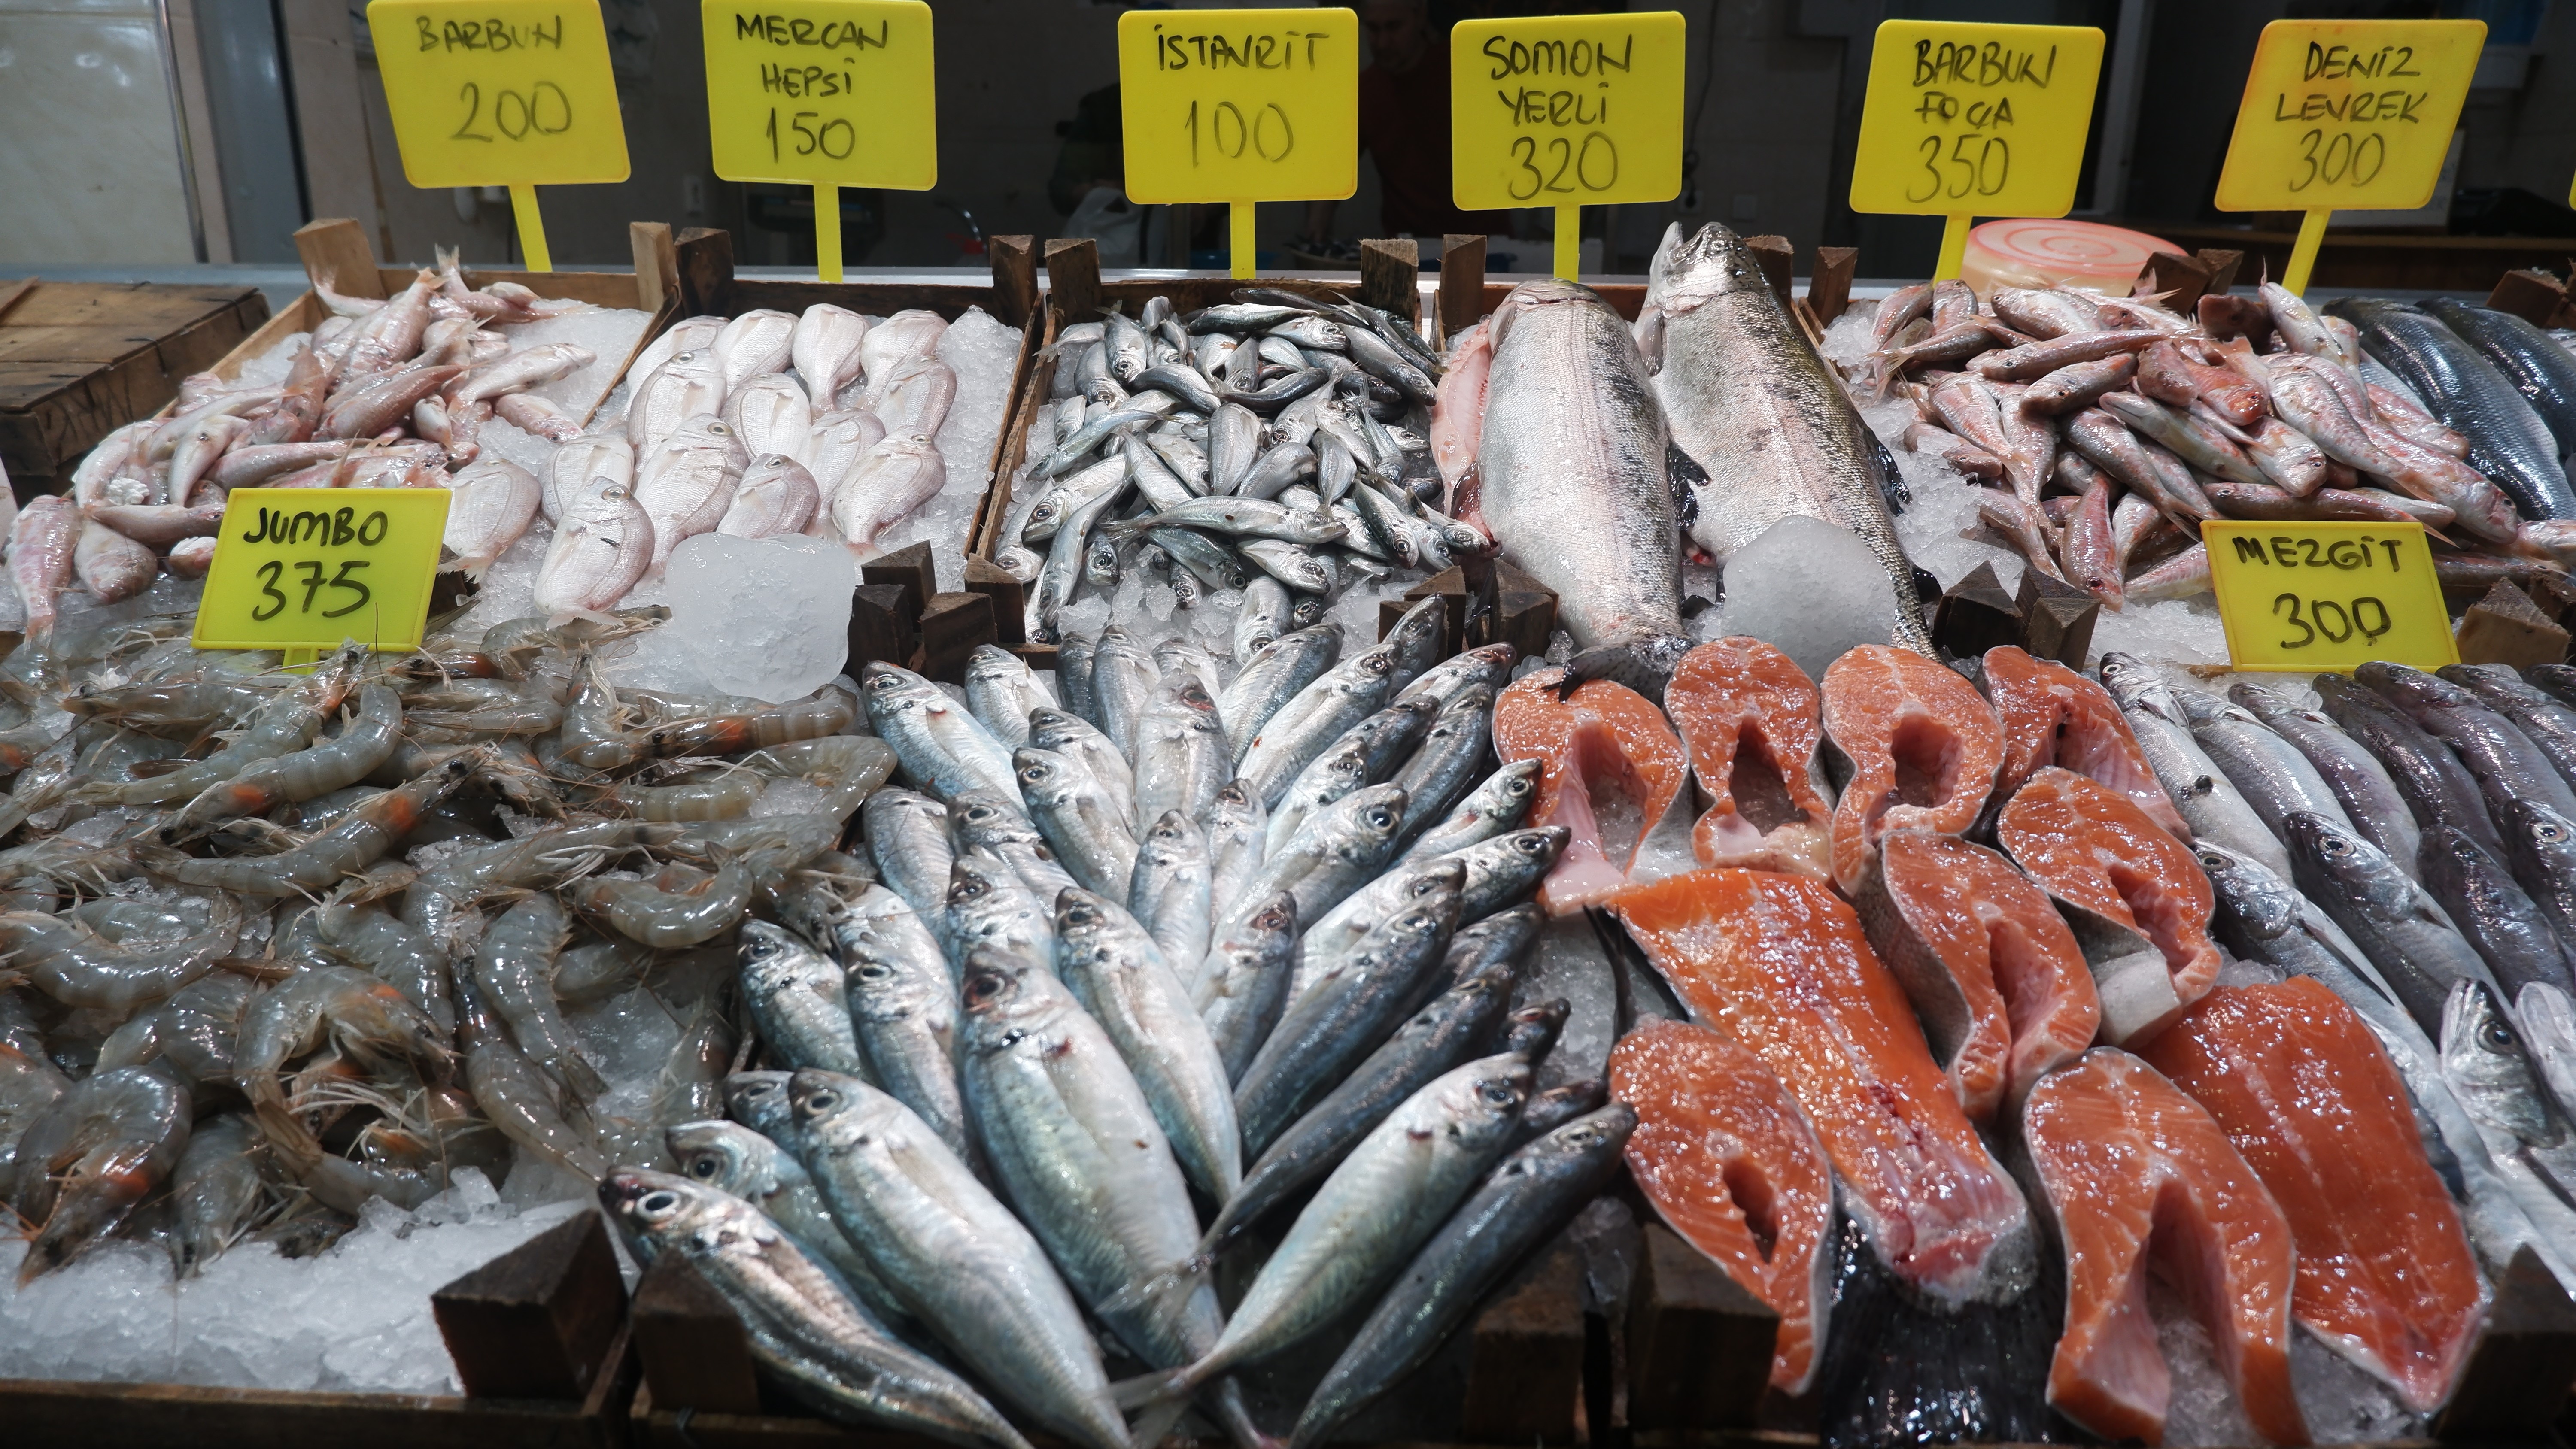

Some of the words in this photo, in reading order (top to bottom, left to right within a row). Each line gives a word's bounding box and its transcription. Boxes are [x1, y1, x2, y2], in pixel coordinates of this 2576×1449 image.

[416, 15, 562, 53] BARBUN
[736, 13, 888, 51] MERCAN
[1154, 24, 1330, 71] İSTAVRİT
[761, 57, 855, 99] HEPSİ
[1483, 34, 1633, 80] SOMON
[1913, 39, 2057, 89] BARBUN
[2304, 40, 2421, 82] DENİZ
[449, 81, 573, 143] 200
[1498, 82, 1609, 127] YERLİ
[2275, 90, 2428, 124] LEVREK
[766, 107, 855, 164] 150
[1184, 100, 1294, 168] 100
[1508, 130, 1619, 200] 320
[1906, 133, 2009, 203] 350
[2288, 128, 2385, 193] 300
[243, 506, 388, 547] JUMBO
[2232, 535, 2403, 573] MEZGİT
[252, 560, 371, 621] 375
[2272, 592, 2391, 647] 300
